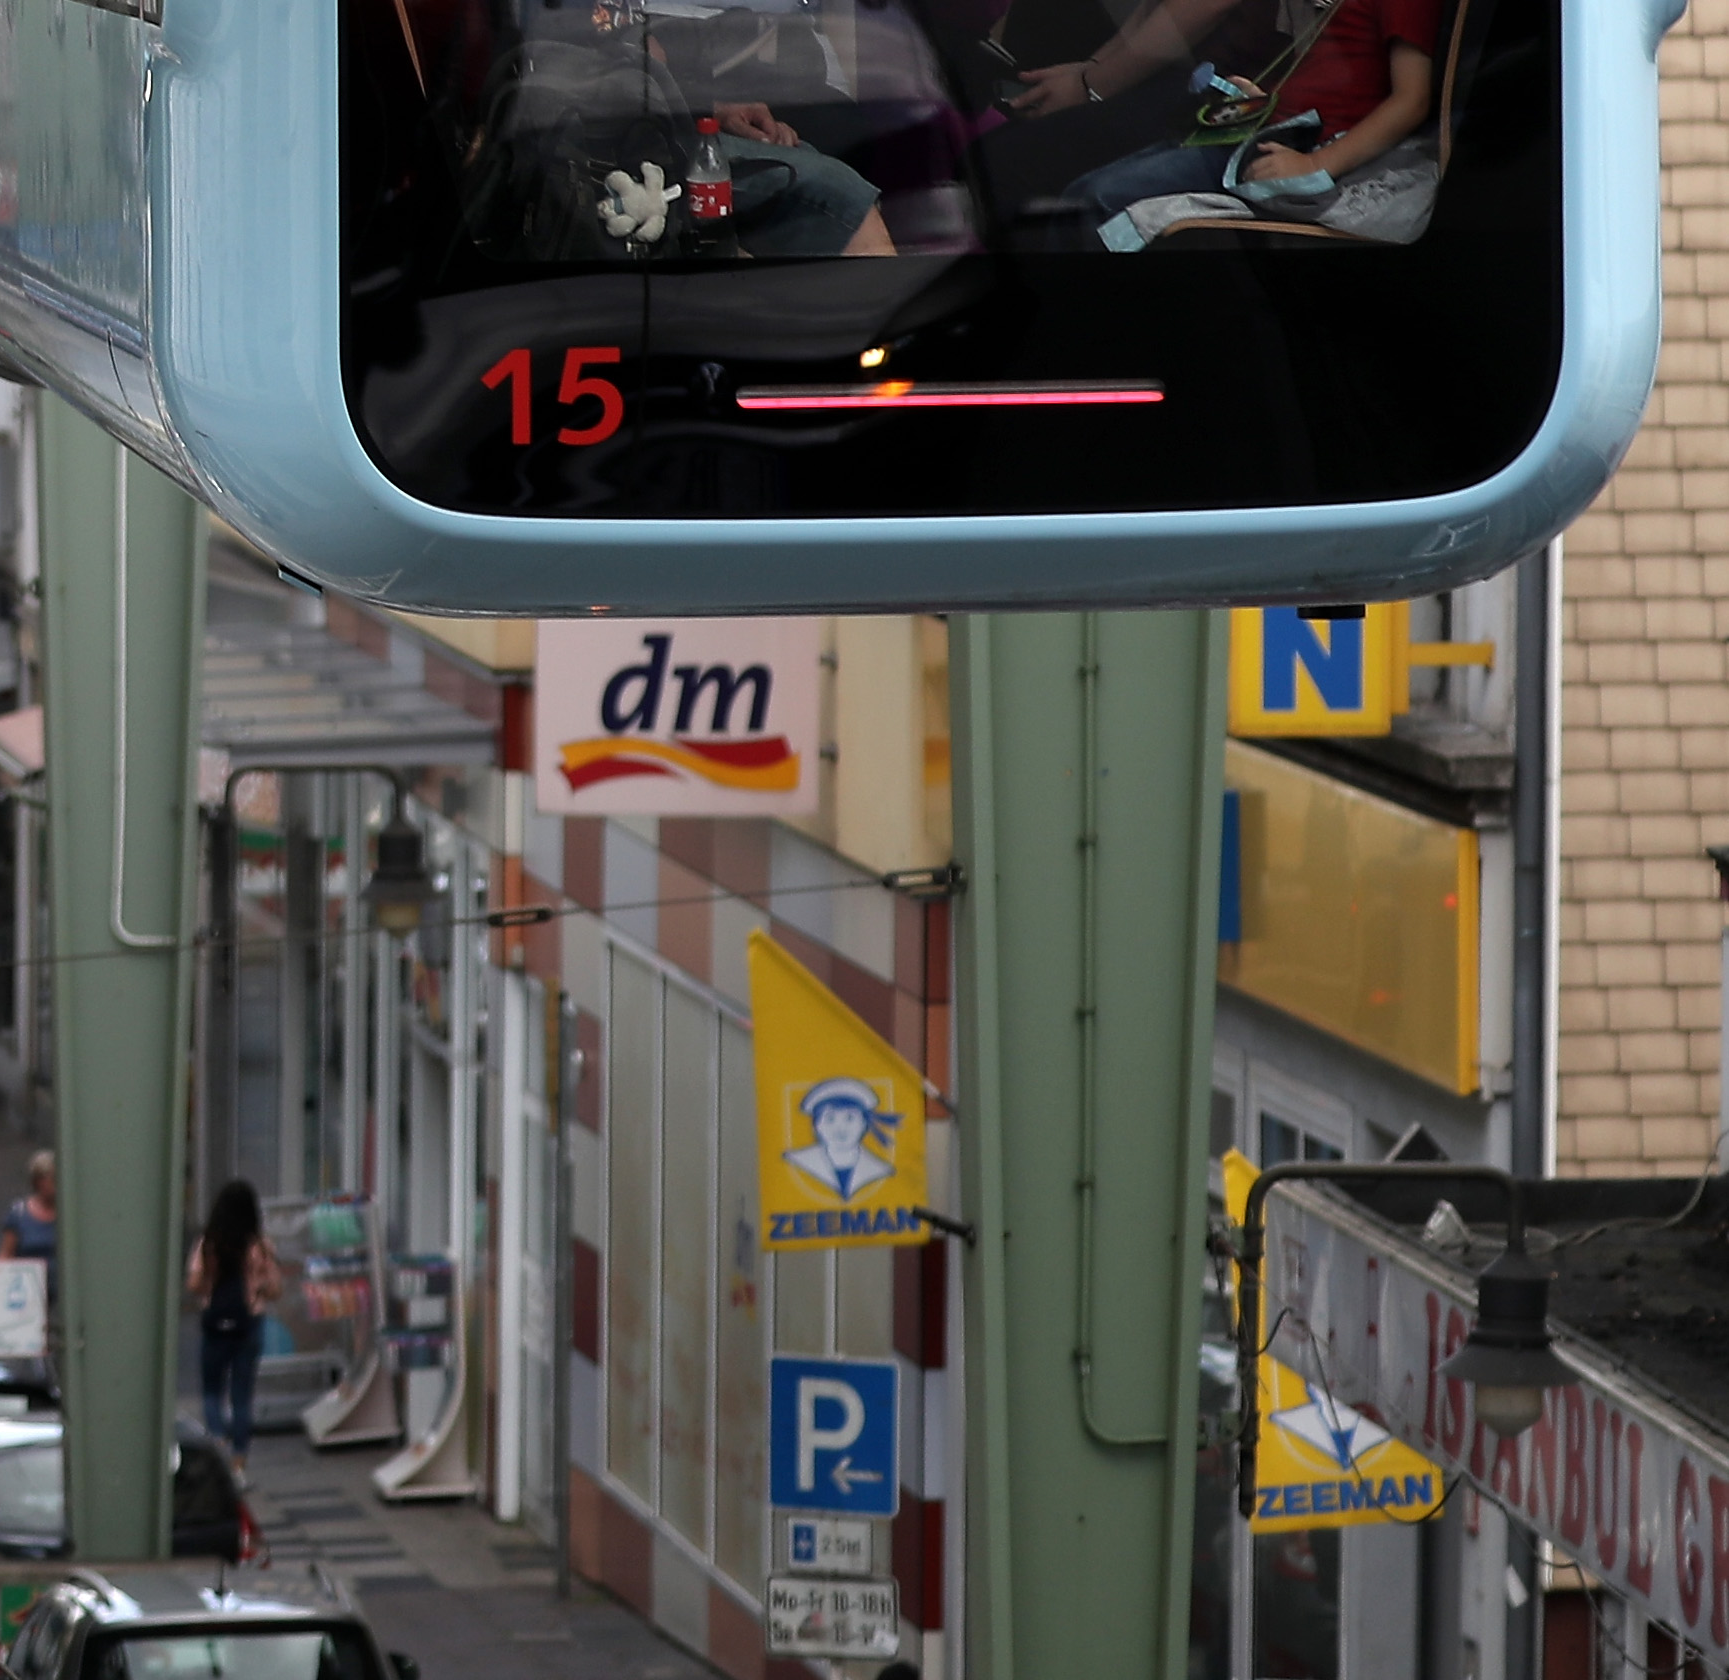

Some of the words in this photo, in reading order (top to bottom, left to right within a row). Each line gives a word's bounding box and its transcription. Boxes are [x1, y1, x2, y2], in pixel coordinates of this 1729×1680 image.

[481, 345, 624, 447] 15
[600, 633, 773, 734] dm
[1262, 606, 1365, 711] N
[768, 1205, 922, 1241] ZEEMAN
[796, 1376, 866, 1492] P
[1258, 1473, 1434, 1519] ZEEMAN
